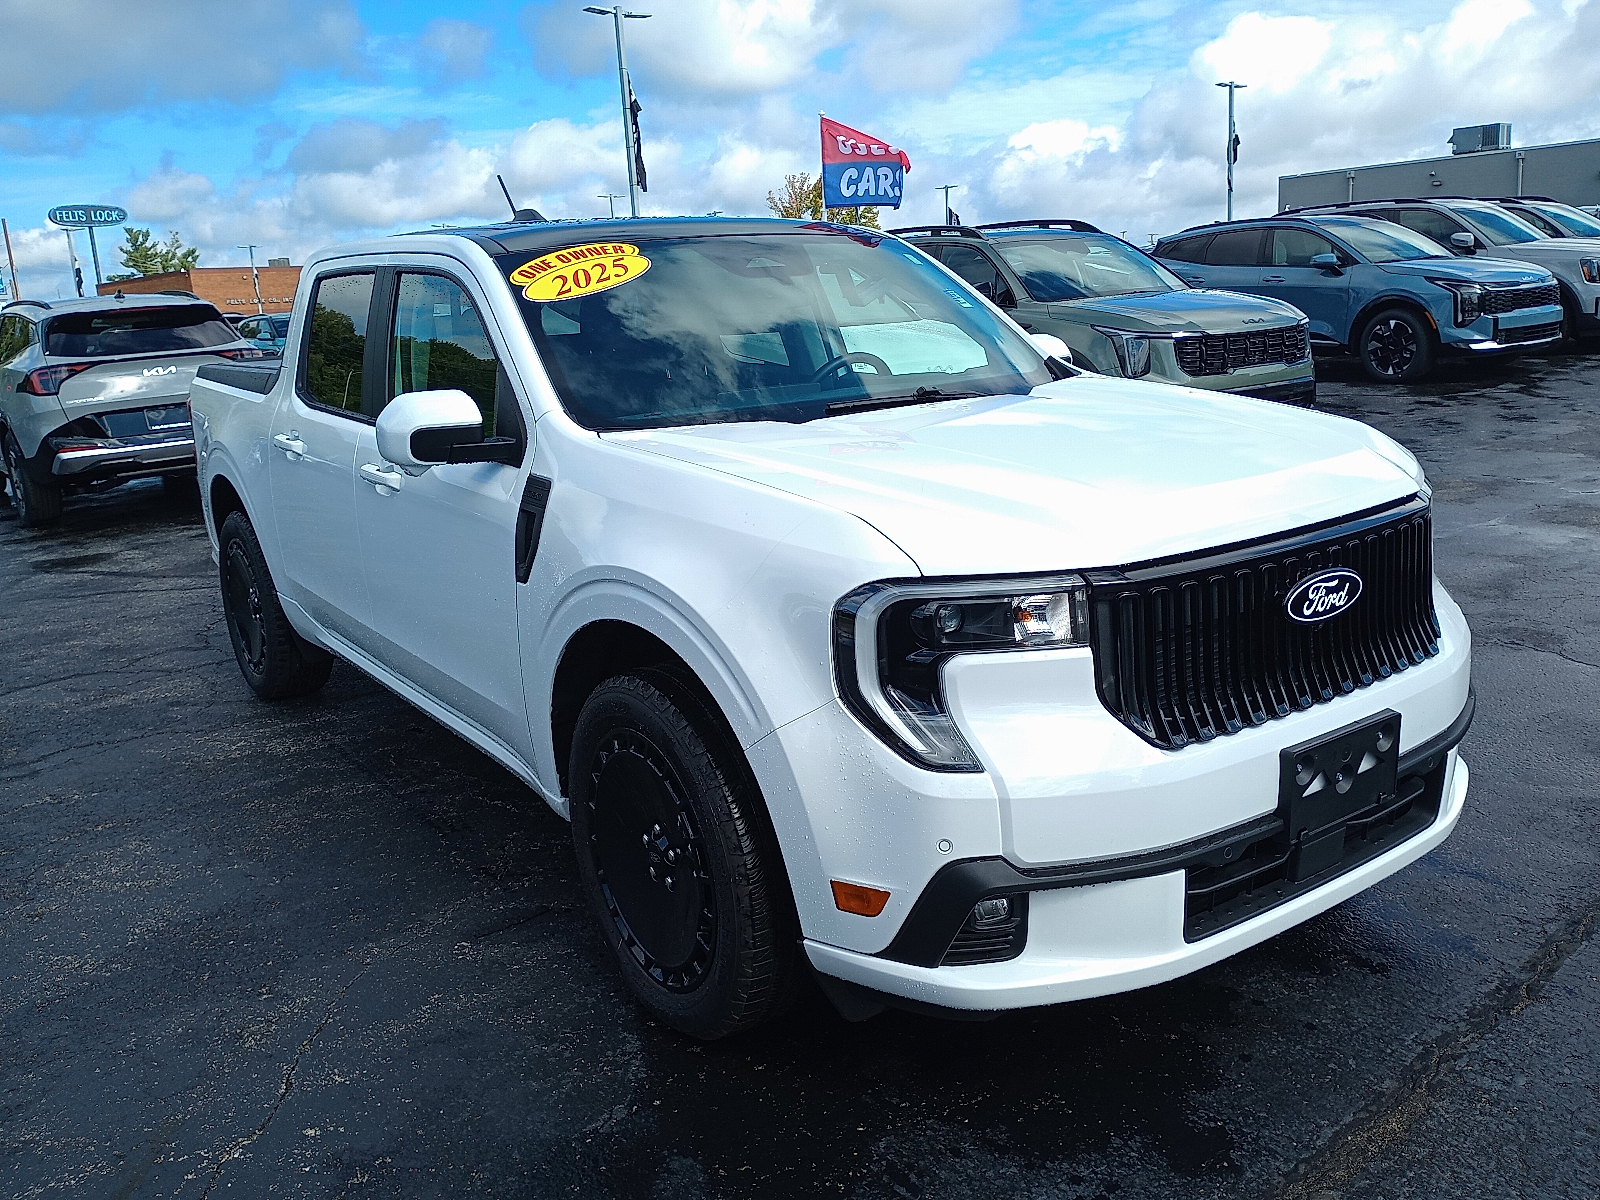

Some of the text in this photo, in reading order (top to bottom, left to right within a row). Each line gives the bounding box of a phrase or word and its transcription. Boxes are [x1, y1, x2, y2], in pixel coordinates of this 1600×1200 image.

[91, 210, 119, 222] LOCK
[517, 245, 625, 280] ONE OWNER
[552, 256, 629, 297] 2025
[142, 365, 177, 377] KIA
[1302, 578, 1350, 616] Ford
